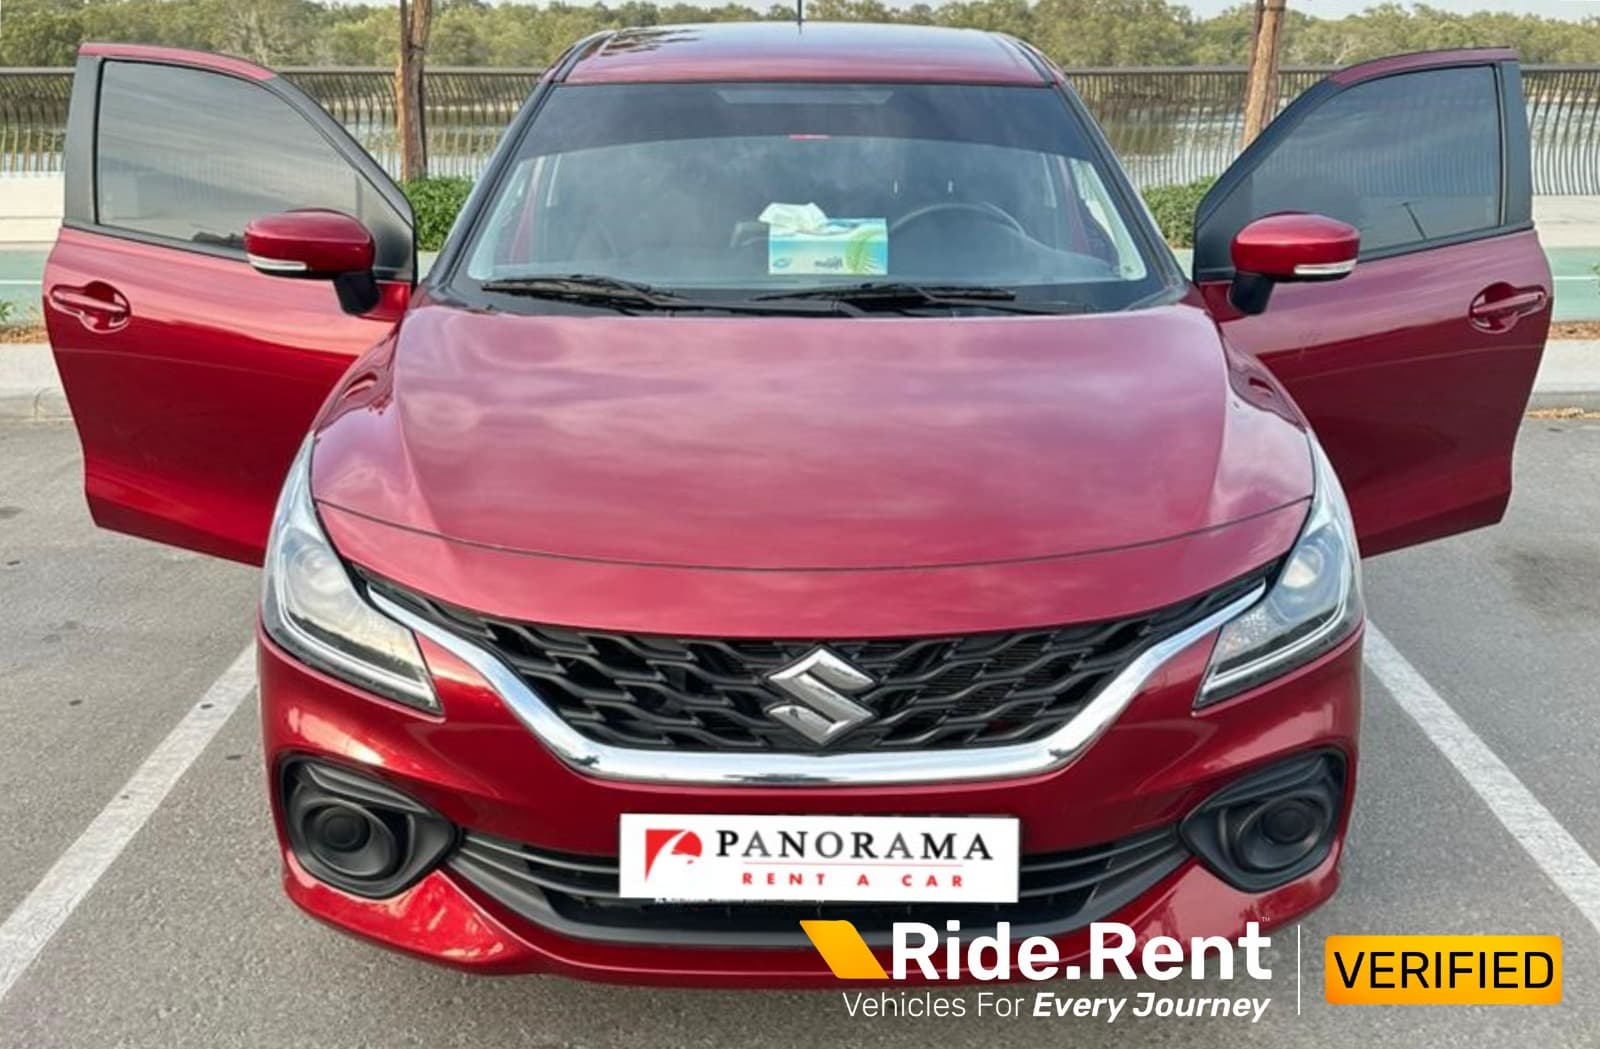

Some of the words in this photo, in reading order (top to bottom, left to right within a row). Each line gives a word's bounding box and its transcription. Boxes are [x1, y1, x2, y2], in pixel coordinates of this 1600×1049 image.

[716, 829, 993, 861] PANORAMA
[742, 872, 825, 886] RENT
[857, 874, 869, 886] A
[901, 875, 963, 888] CAR
